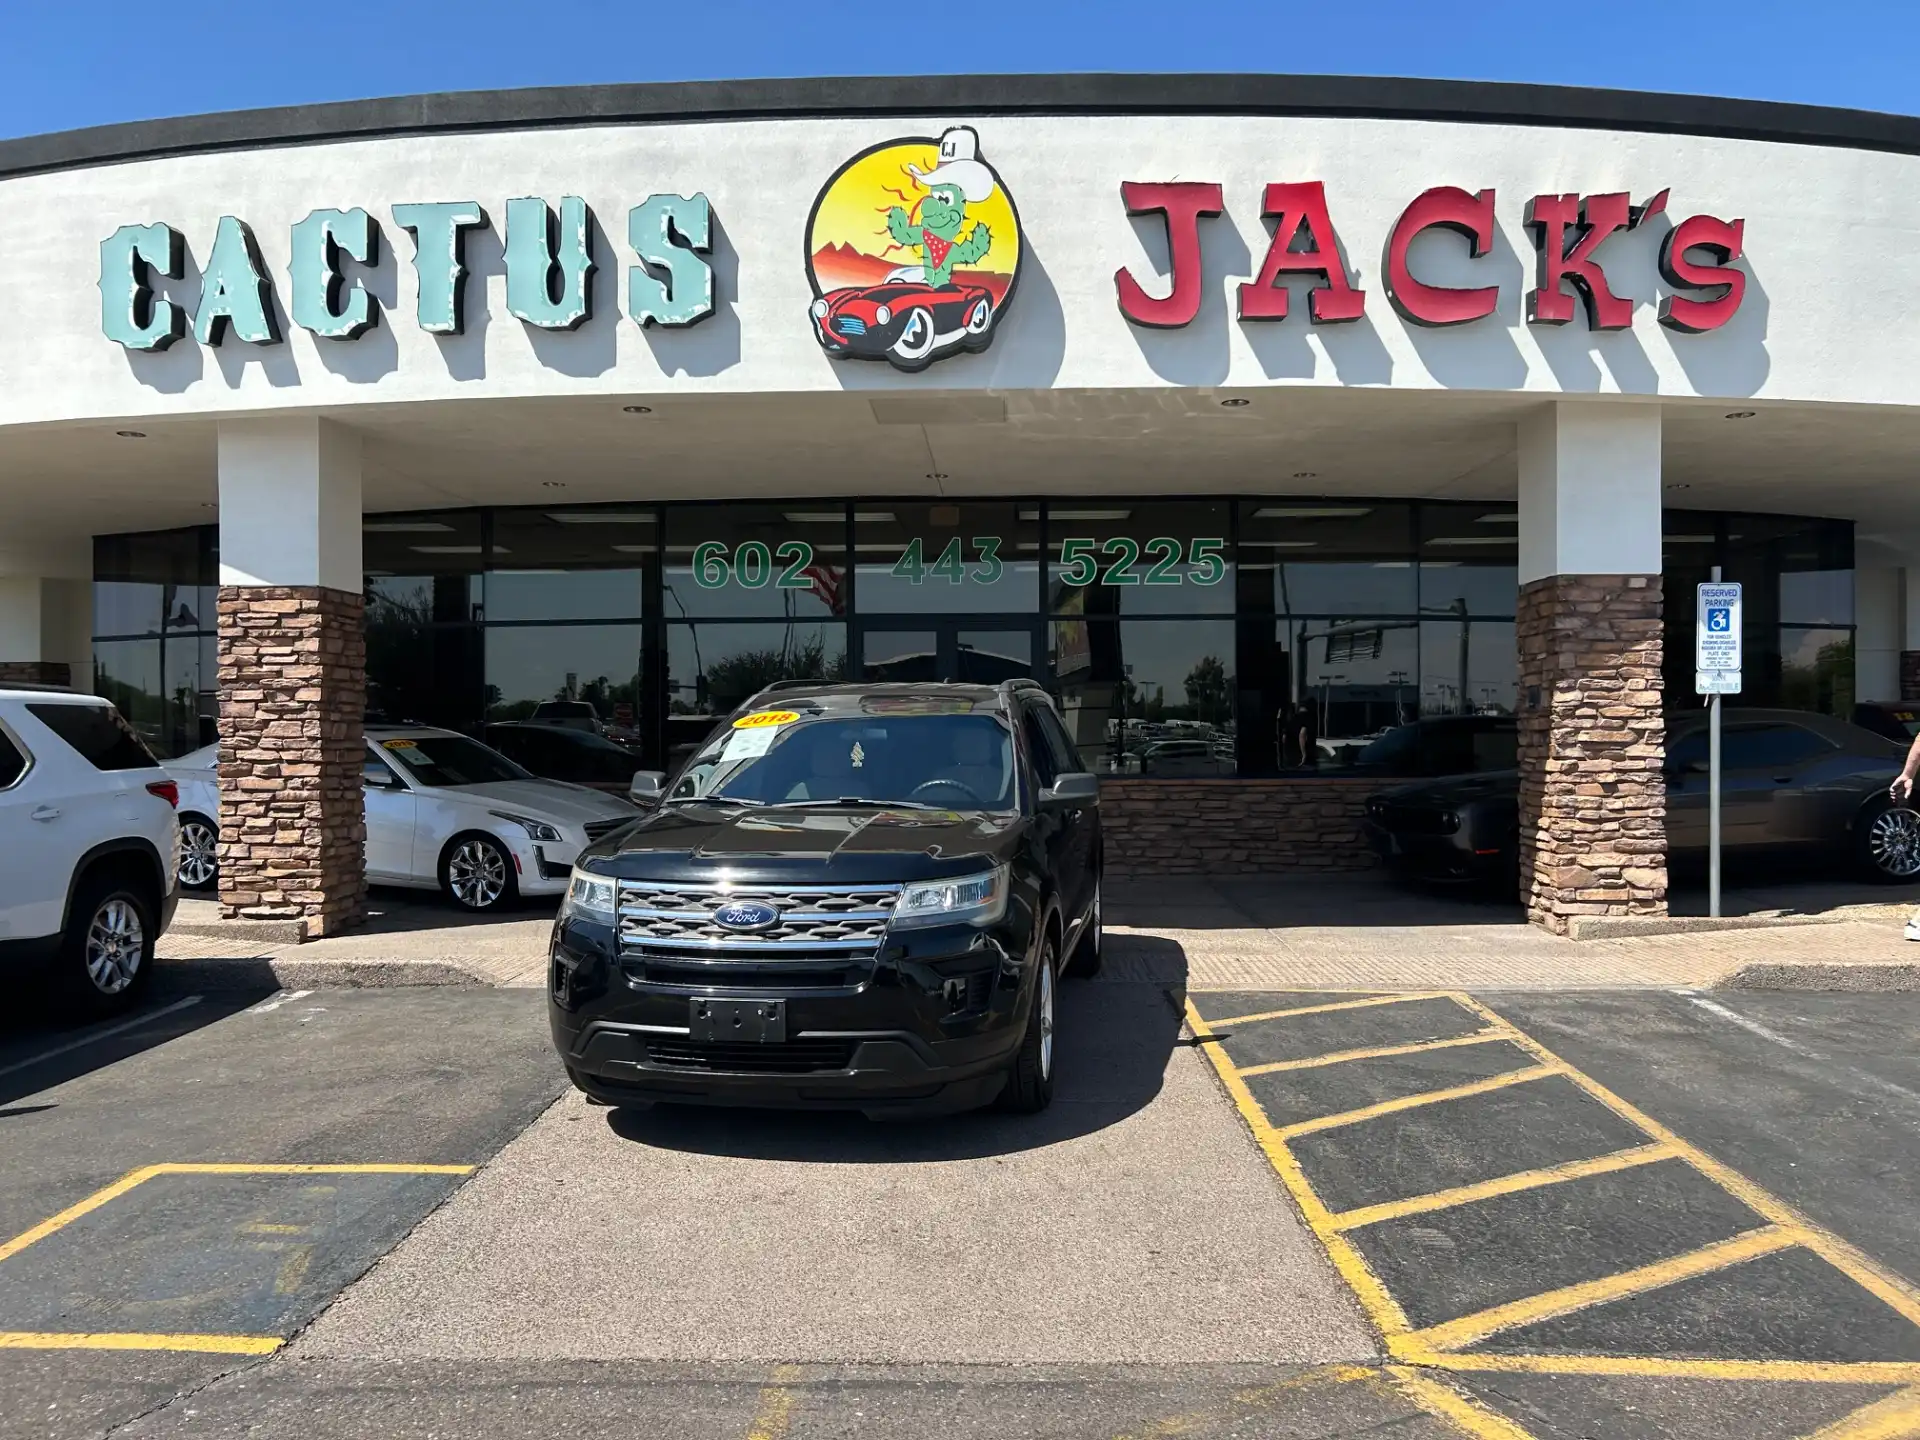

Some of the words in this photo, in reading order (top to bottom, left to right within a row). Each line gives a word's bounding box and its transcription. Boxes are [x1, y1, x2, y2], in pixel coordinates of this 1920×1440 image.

[940, 141, 957, 159] CJ
[97, 191, 716, 352] CACTUS
[692, 539, 815, 590] 602
[890, 535, 1004, 586] 443
[1058, 536, 1226, 587] 5225
[1701, 588, 1738, 597] RESERVED
[1704, 598, 1735, 607] PARKING
[738, 712, 794, 727] 2018
[726, 906, 761, 923] Ford
